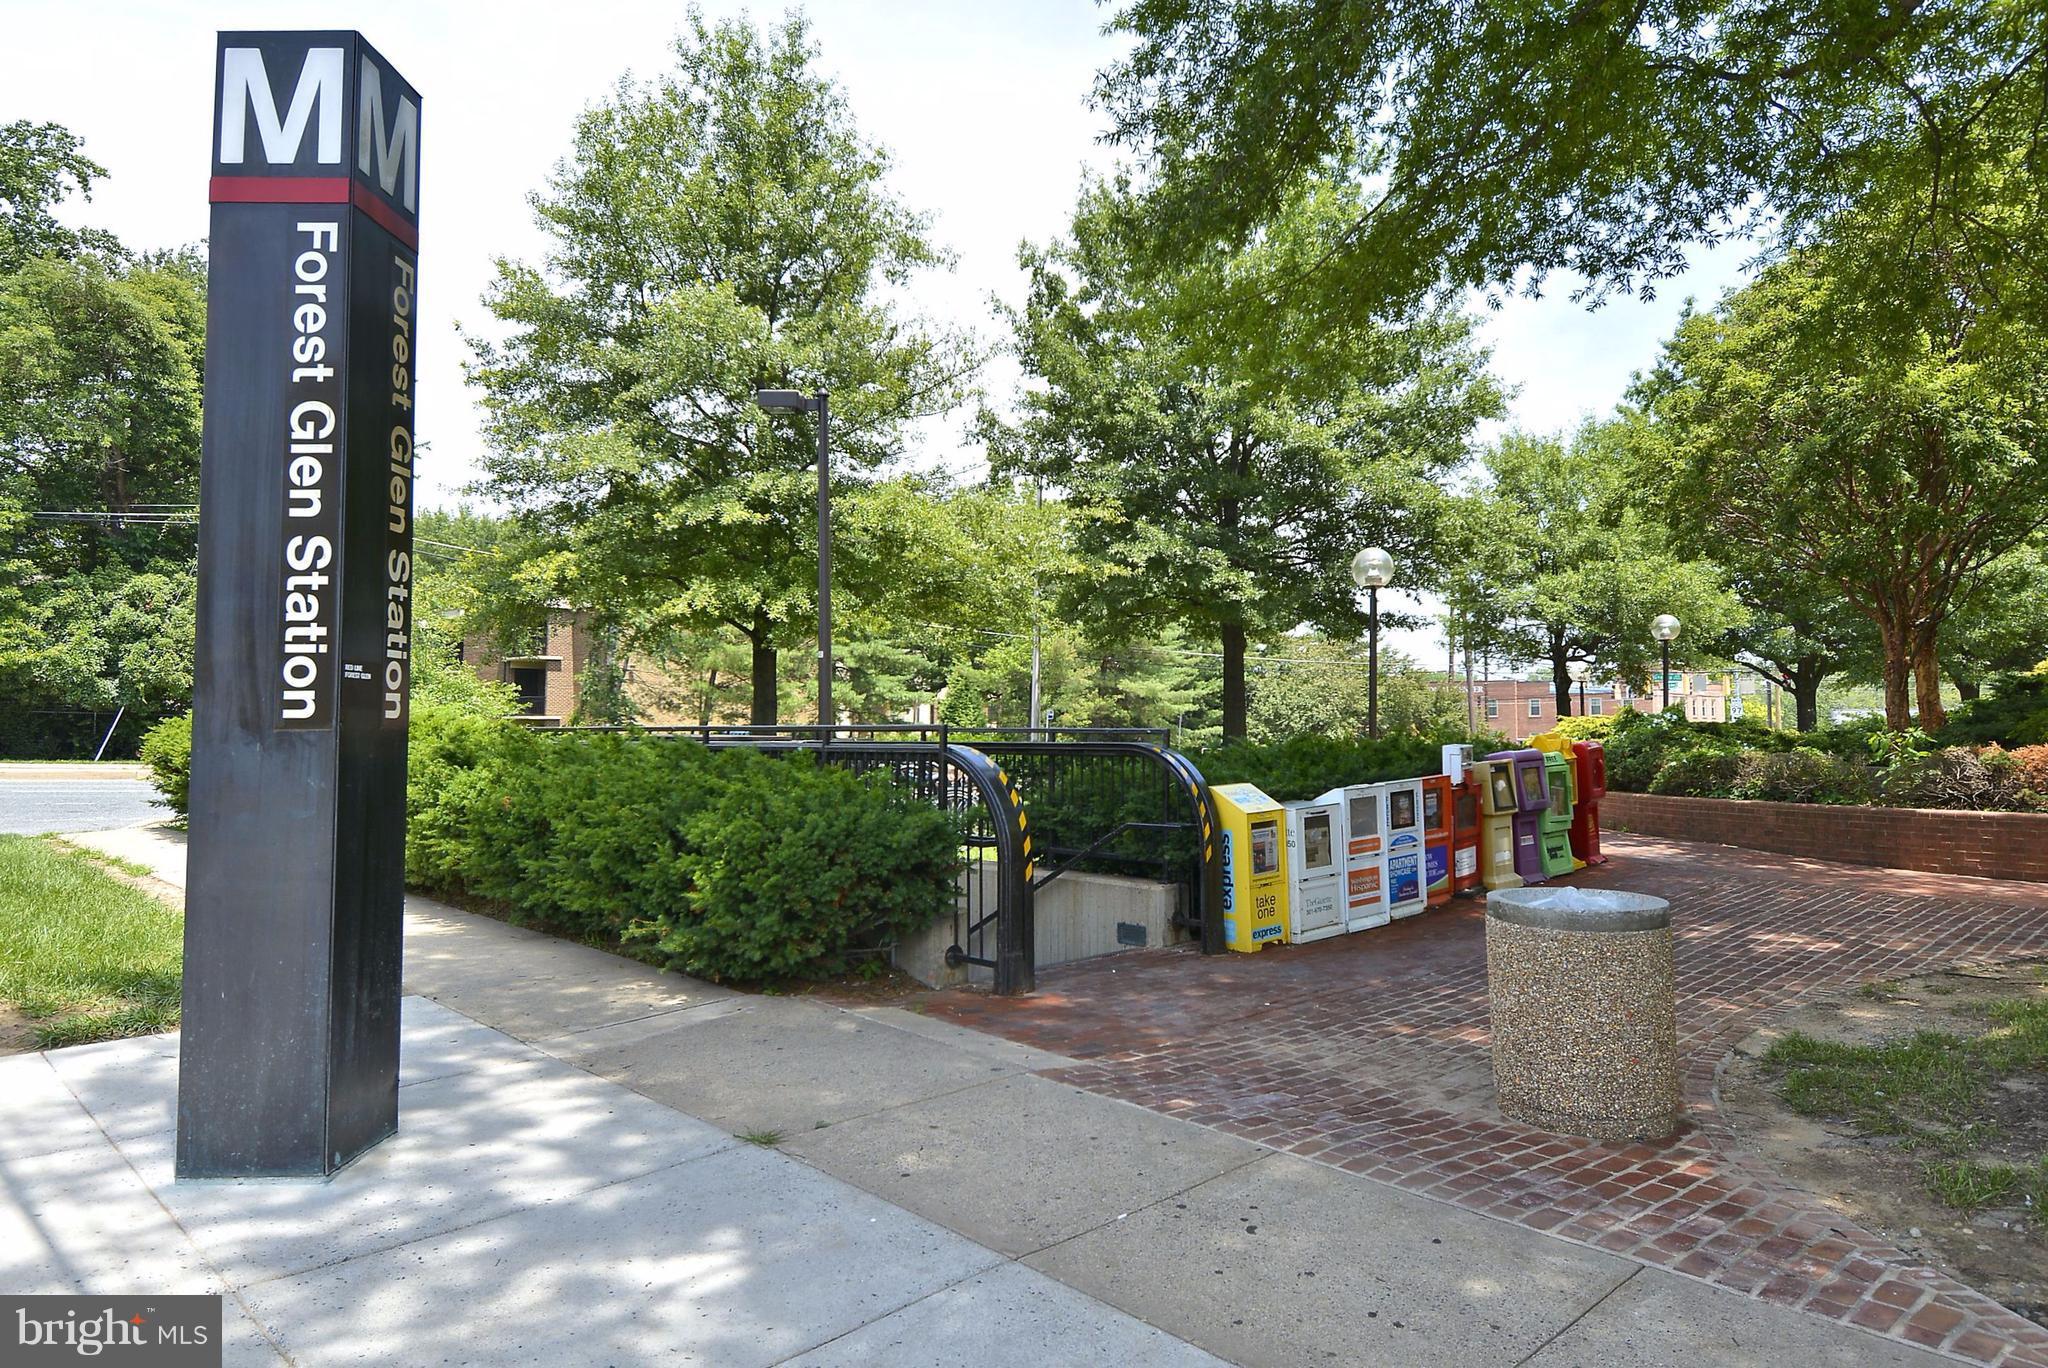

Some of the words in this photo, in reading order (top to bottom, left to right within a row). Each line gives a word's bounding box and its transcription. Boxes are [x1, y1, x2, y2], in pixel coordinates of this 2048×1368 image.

[220, 47, 345, 164] M
[358, 53, 418, 215] M
[292, 222, 339, 382] Forest
[392, 255, 414, 411] Forest
[288, 400, 336, 518] Glen
[389, 425, 412, 534] Glen
[282, 535, 333, 719] Station
[384, 549, 410, 719] Station
[1222, 833, 1234, 911] express
[1255, 894, 1276, 910] take
[1257, 905, 1275, 920] one
[1252, 924, 1282, 940] express
